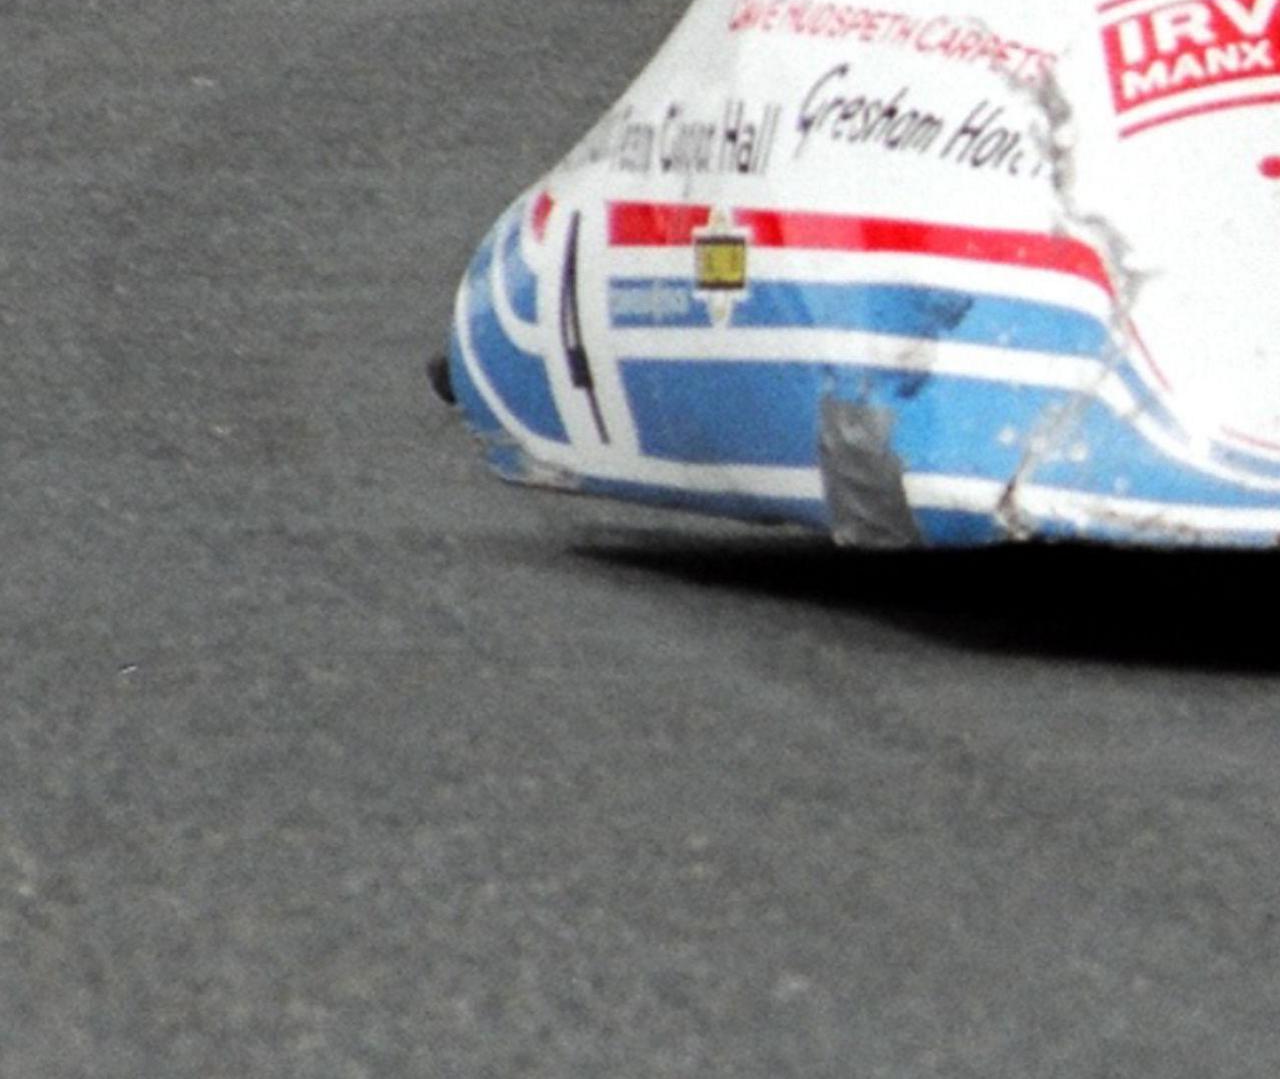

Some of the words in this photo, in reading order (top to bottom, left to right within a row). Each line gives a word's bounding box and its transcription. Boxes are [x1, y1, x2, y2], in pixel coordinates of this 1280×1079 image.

[795, 62, 943, 160] Gresham
[1122, 38, 1274, 101] MANX
[717, 98, 782, 176] Hall
[559, 208, 611, 445] 4
